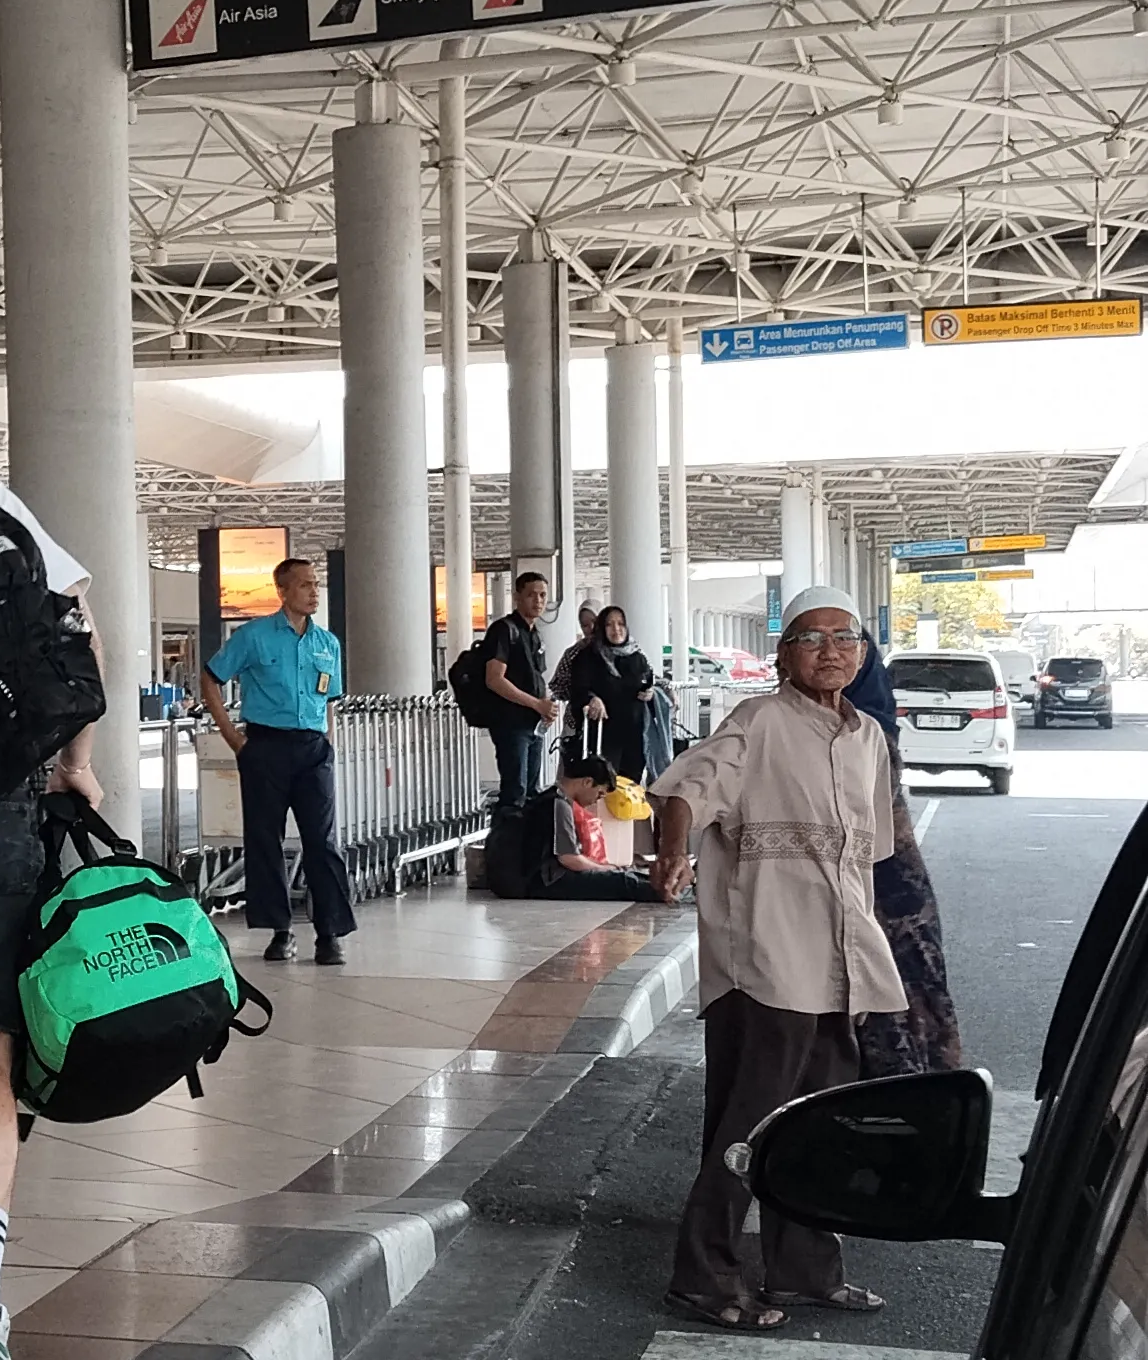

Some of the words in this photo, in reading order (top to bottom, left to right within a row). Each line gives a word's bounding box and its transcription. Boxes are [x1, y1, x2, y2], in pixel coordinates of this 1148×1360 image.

[218, 8, 240, 25] Air
[243, 4, 278, 21] Asia
[967, 312, 997, 324] Batas
[999, 309, 1048, 322] Maksimal
[1050, 307, 1095, 319] Berhenti
[1097, 306, 1104, 316] 3
[1106, 304, 1136, 316] Menit
[758, 329, 782, 340] Area
[783, 323, 843, 339] Menurunkan
[845, 320, 903, 336] Penumpang
[967, 326, 1011, 337] Passenger
[1013, 325, 1034, 336] Drop
[1035, 324, 1049, 333] Off
[1051, 323, 1072, 333] Time
[1073, 322, 1079, 332] 3
[1081, 321, 1115, 331] Minutes
[1116, 320, 1134, 330] Max
[759, 343, 809, 355] Passenger
[811, 341, 835, 353] Drop
[836, 339, 852, 349] Off
[853, 337, 877, 348] Area
[104, 924, 145, 947] THE
[82, 938, 152, 975] NORTH
[107, 952, 158, 983] FACE
